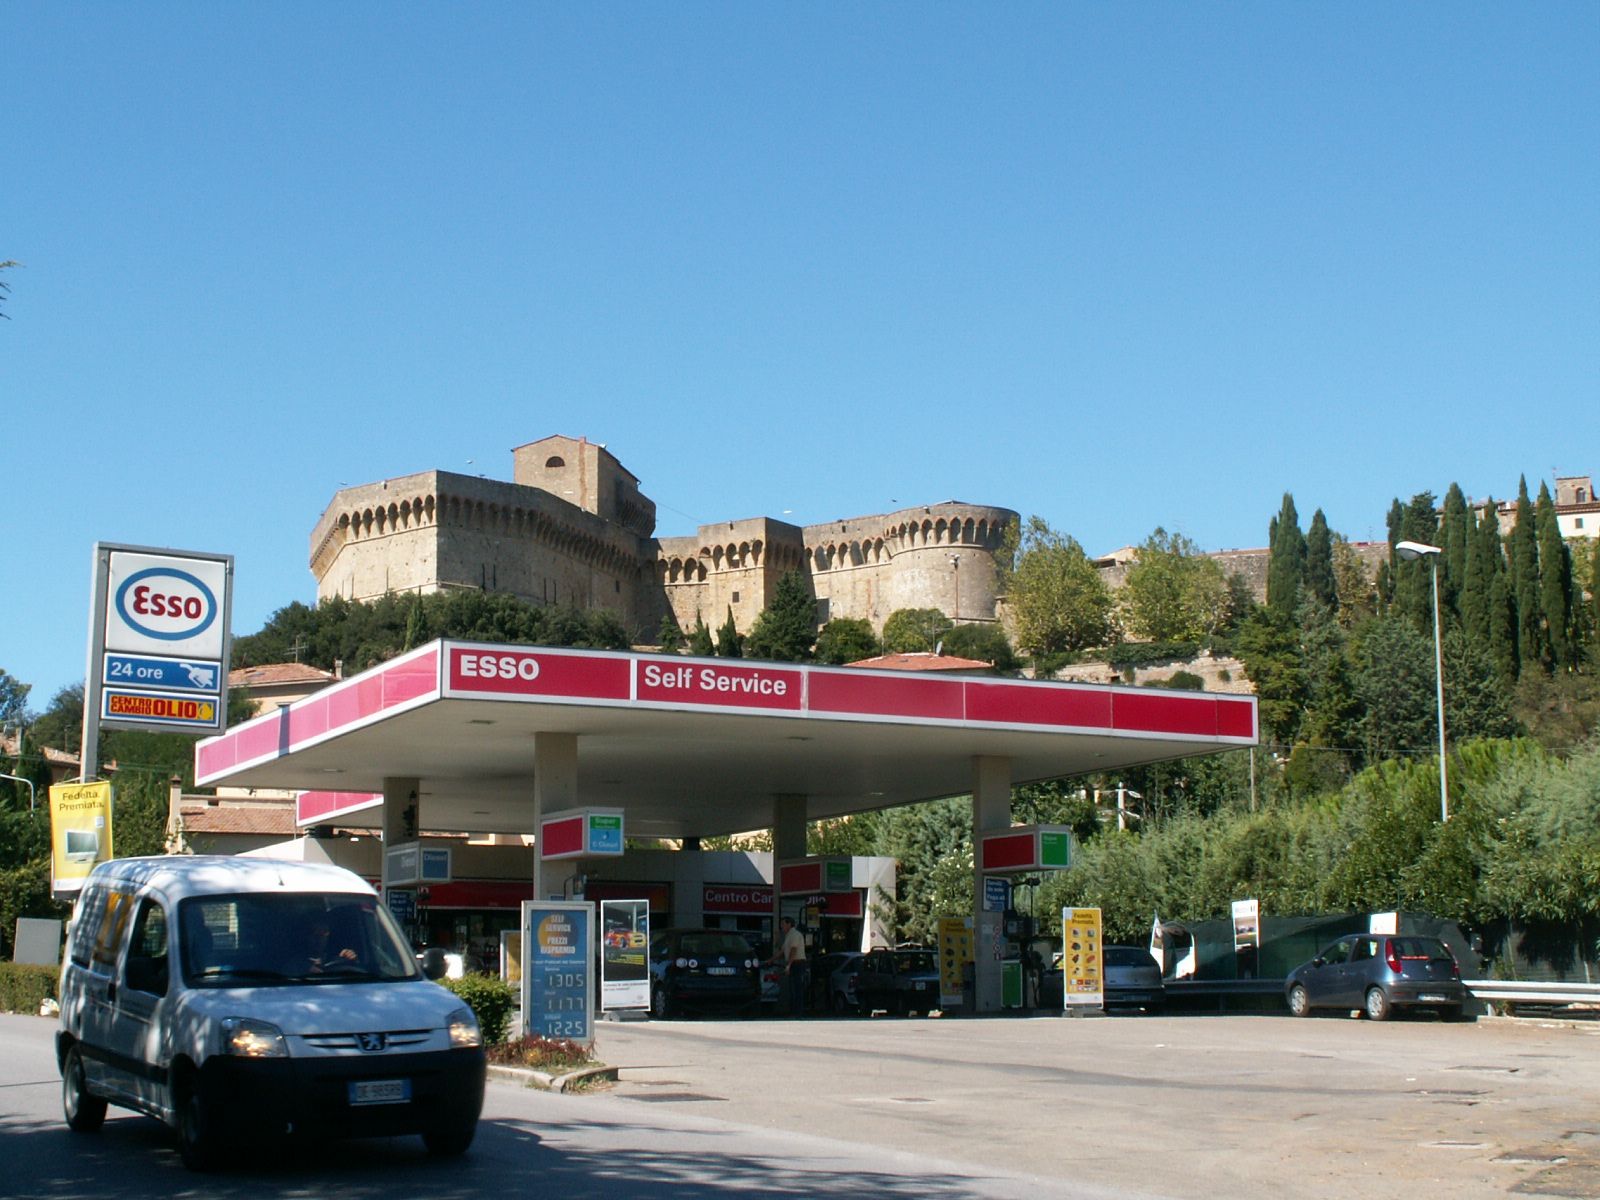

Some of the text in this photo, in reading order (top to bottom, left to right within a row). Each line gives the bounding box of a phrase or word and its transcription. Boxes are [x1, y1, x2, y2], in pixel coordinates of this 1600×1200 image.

[111, 661, 163, 679] 24 ore
[460, 654, 540, 681] ESSO
[644, 664, 788, 696] Self Service
[110, 704, 152, 715] CAMBIO
[111, 695, 197, 719] CENTRO OLIO
[705, 890, 748, 904] Centro
[550, 914, 565, 922] SELF
[545, 924, 571, 932] SERVICE
[547, 936, 568, 944] PREZZI
[540, 946, 576, 954] RISPARMIO
[550, 974, 584, 988] 1305
[548, 997, 584, 1010] 1177
[548, 1020, 584, 1035] 1225
